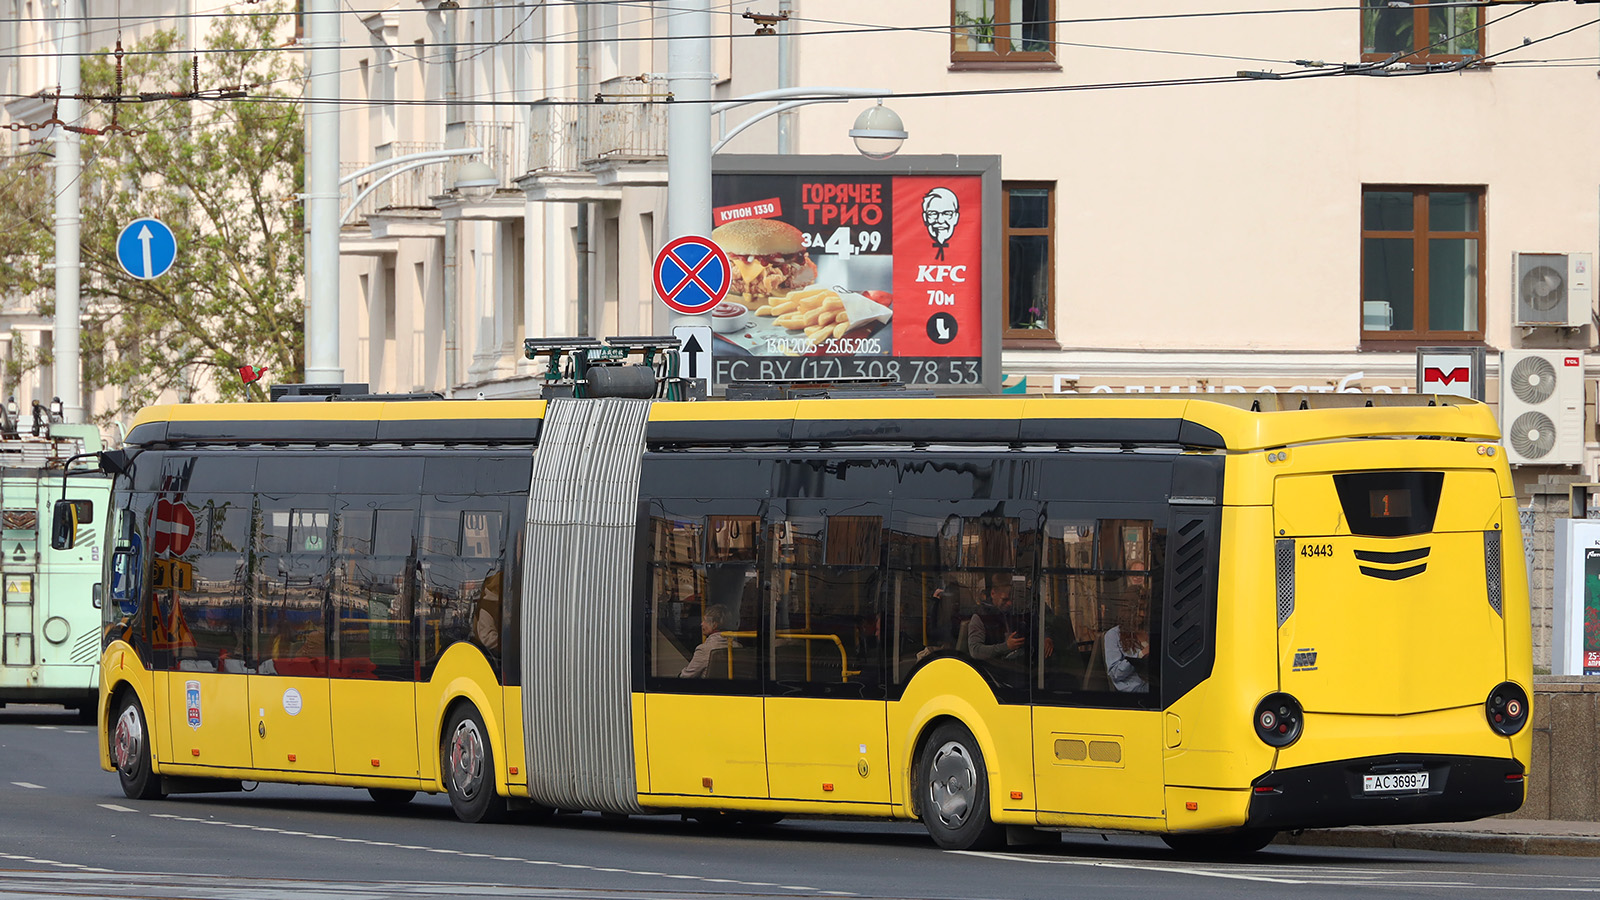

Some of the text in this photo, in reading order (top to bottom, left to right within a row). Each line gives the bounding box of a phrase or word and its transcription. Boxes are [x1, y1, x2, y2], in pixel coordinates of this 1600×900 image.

[802, 183, 882, 204] ГОРЯЧЕЕ
[720, 203, 775, 222] КУПОН 1330
[802, 204, 883, 225] ТРИО
[915, 265, 966, 282] KFC
[910, 360, 939, 384] 78
[948, 360, 979, 384] 53
[1382, 494, 1390, 516] 1
[1300, 544, 1334, 557] 43443
[1374, 774, 1427, 789] AC 3699-7
